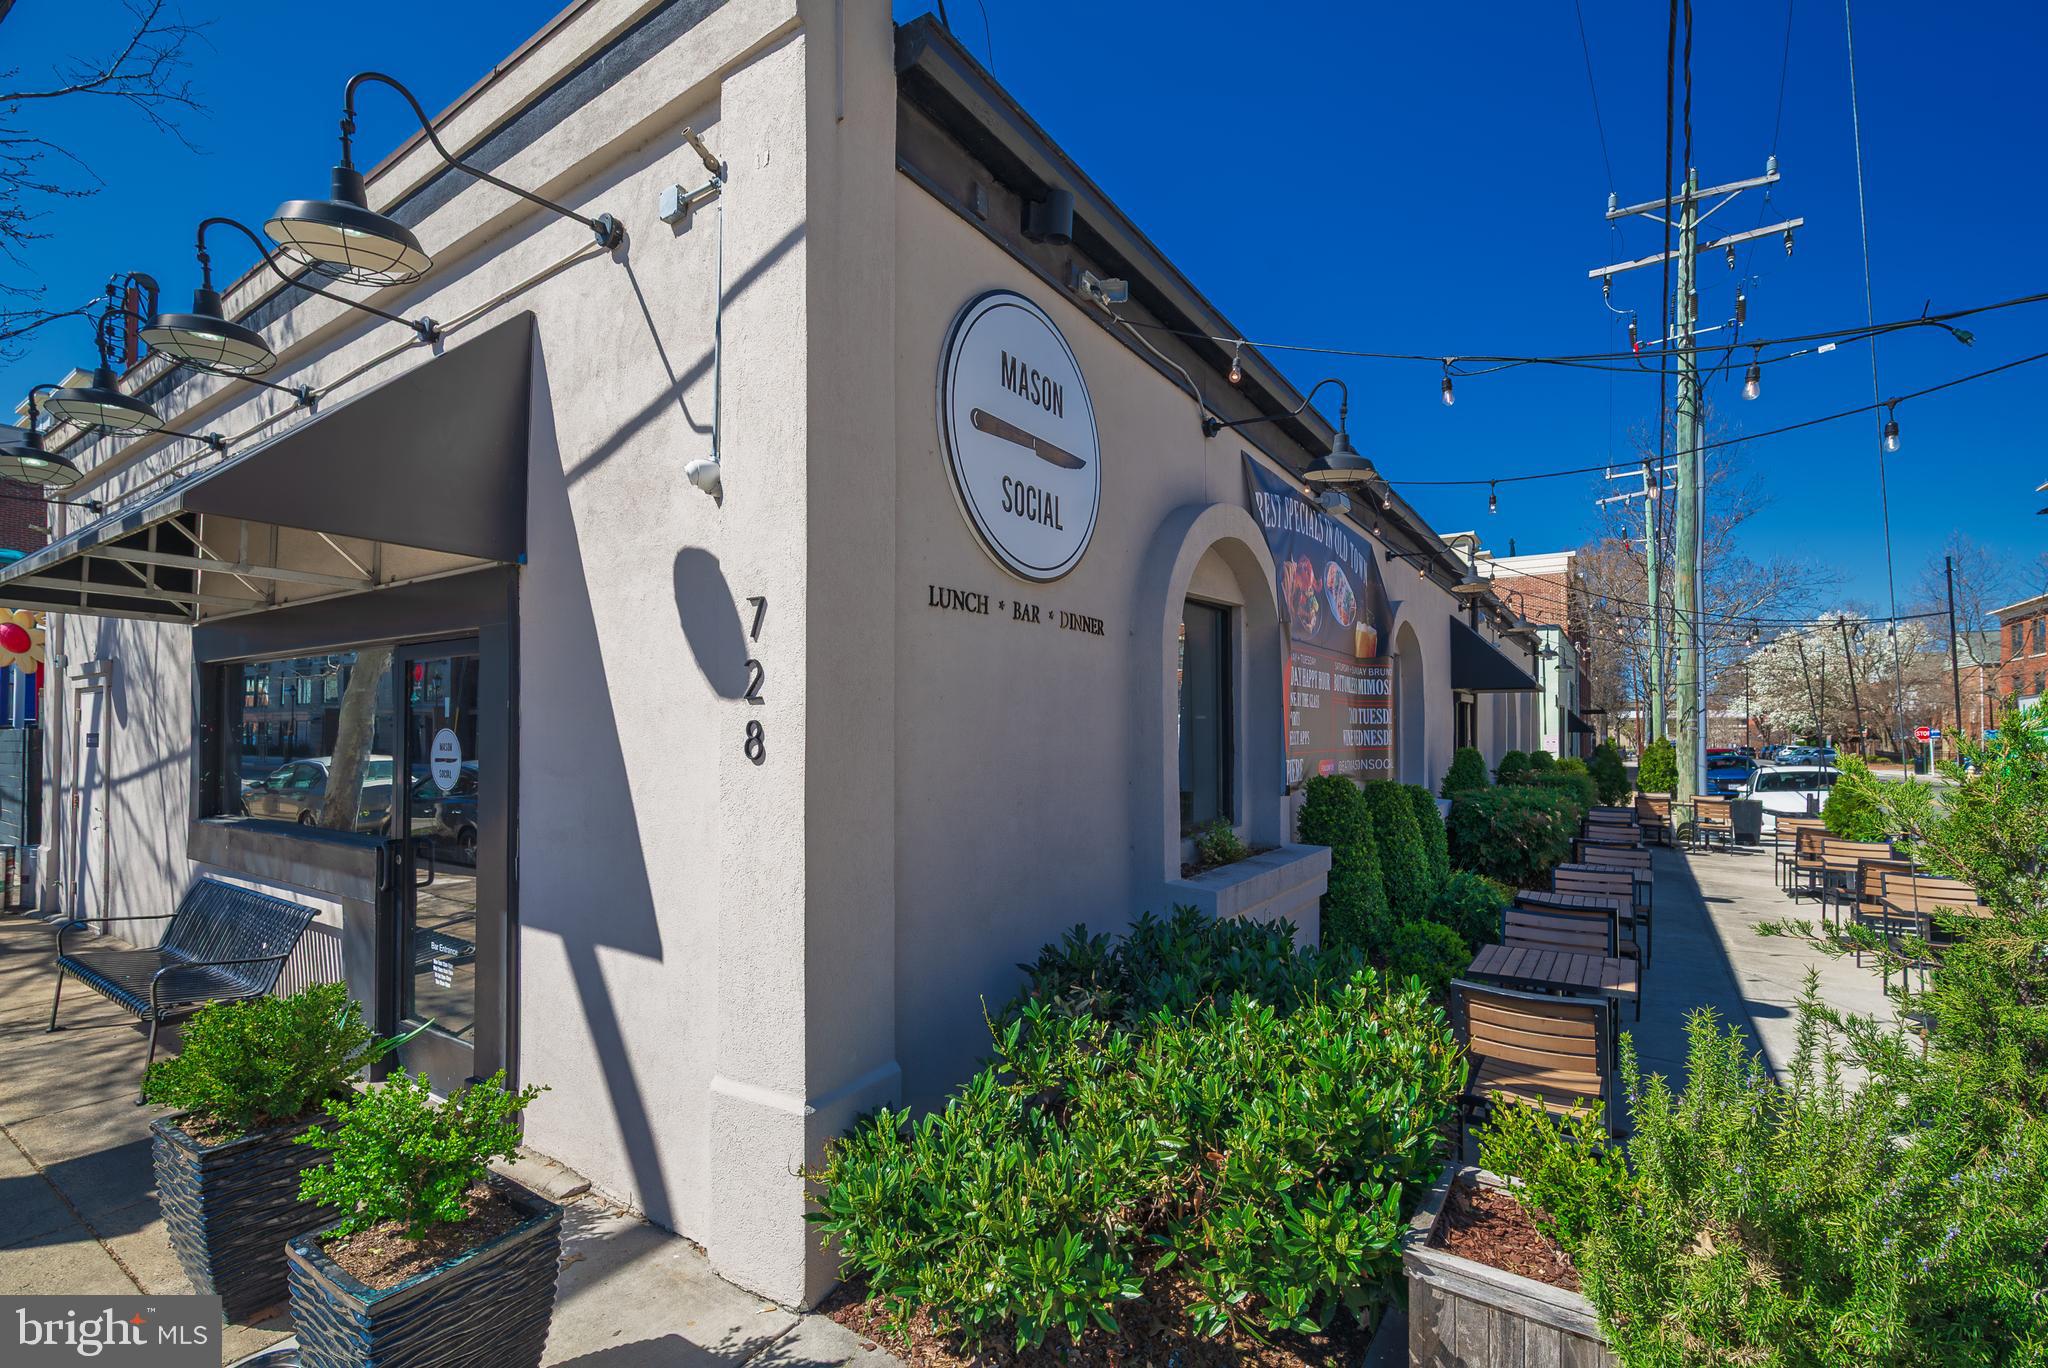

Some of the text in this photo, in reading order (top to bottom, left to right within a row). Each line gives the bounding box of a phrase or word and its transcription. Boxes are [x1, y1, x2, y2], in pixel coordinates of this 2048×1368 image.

[1001, 350, 1064, 419] MASON
[1001, 475, 1064, 531] SOCIAL
[1284, 497, 1324, 543] SPECIALS
[1324, 518, 1333, 551] IN
[1335, 527, 1348, 562] OLD
[928, 585, 1105, 636] LUNCH BAR DINNER
[743, 596, 767, 762] 728
[439, 742, 453, 752] MASON
[438, 769, 452, 779] SOCIAL
[430, 941, 459, 956] Bar Entrance
